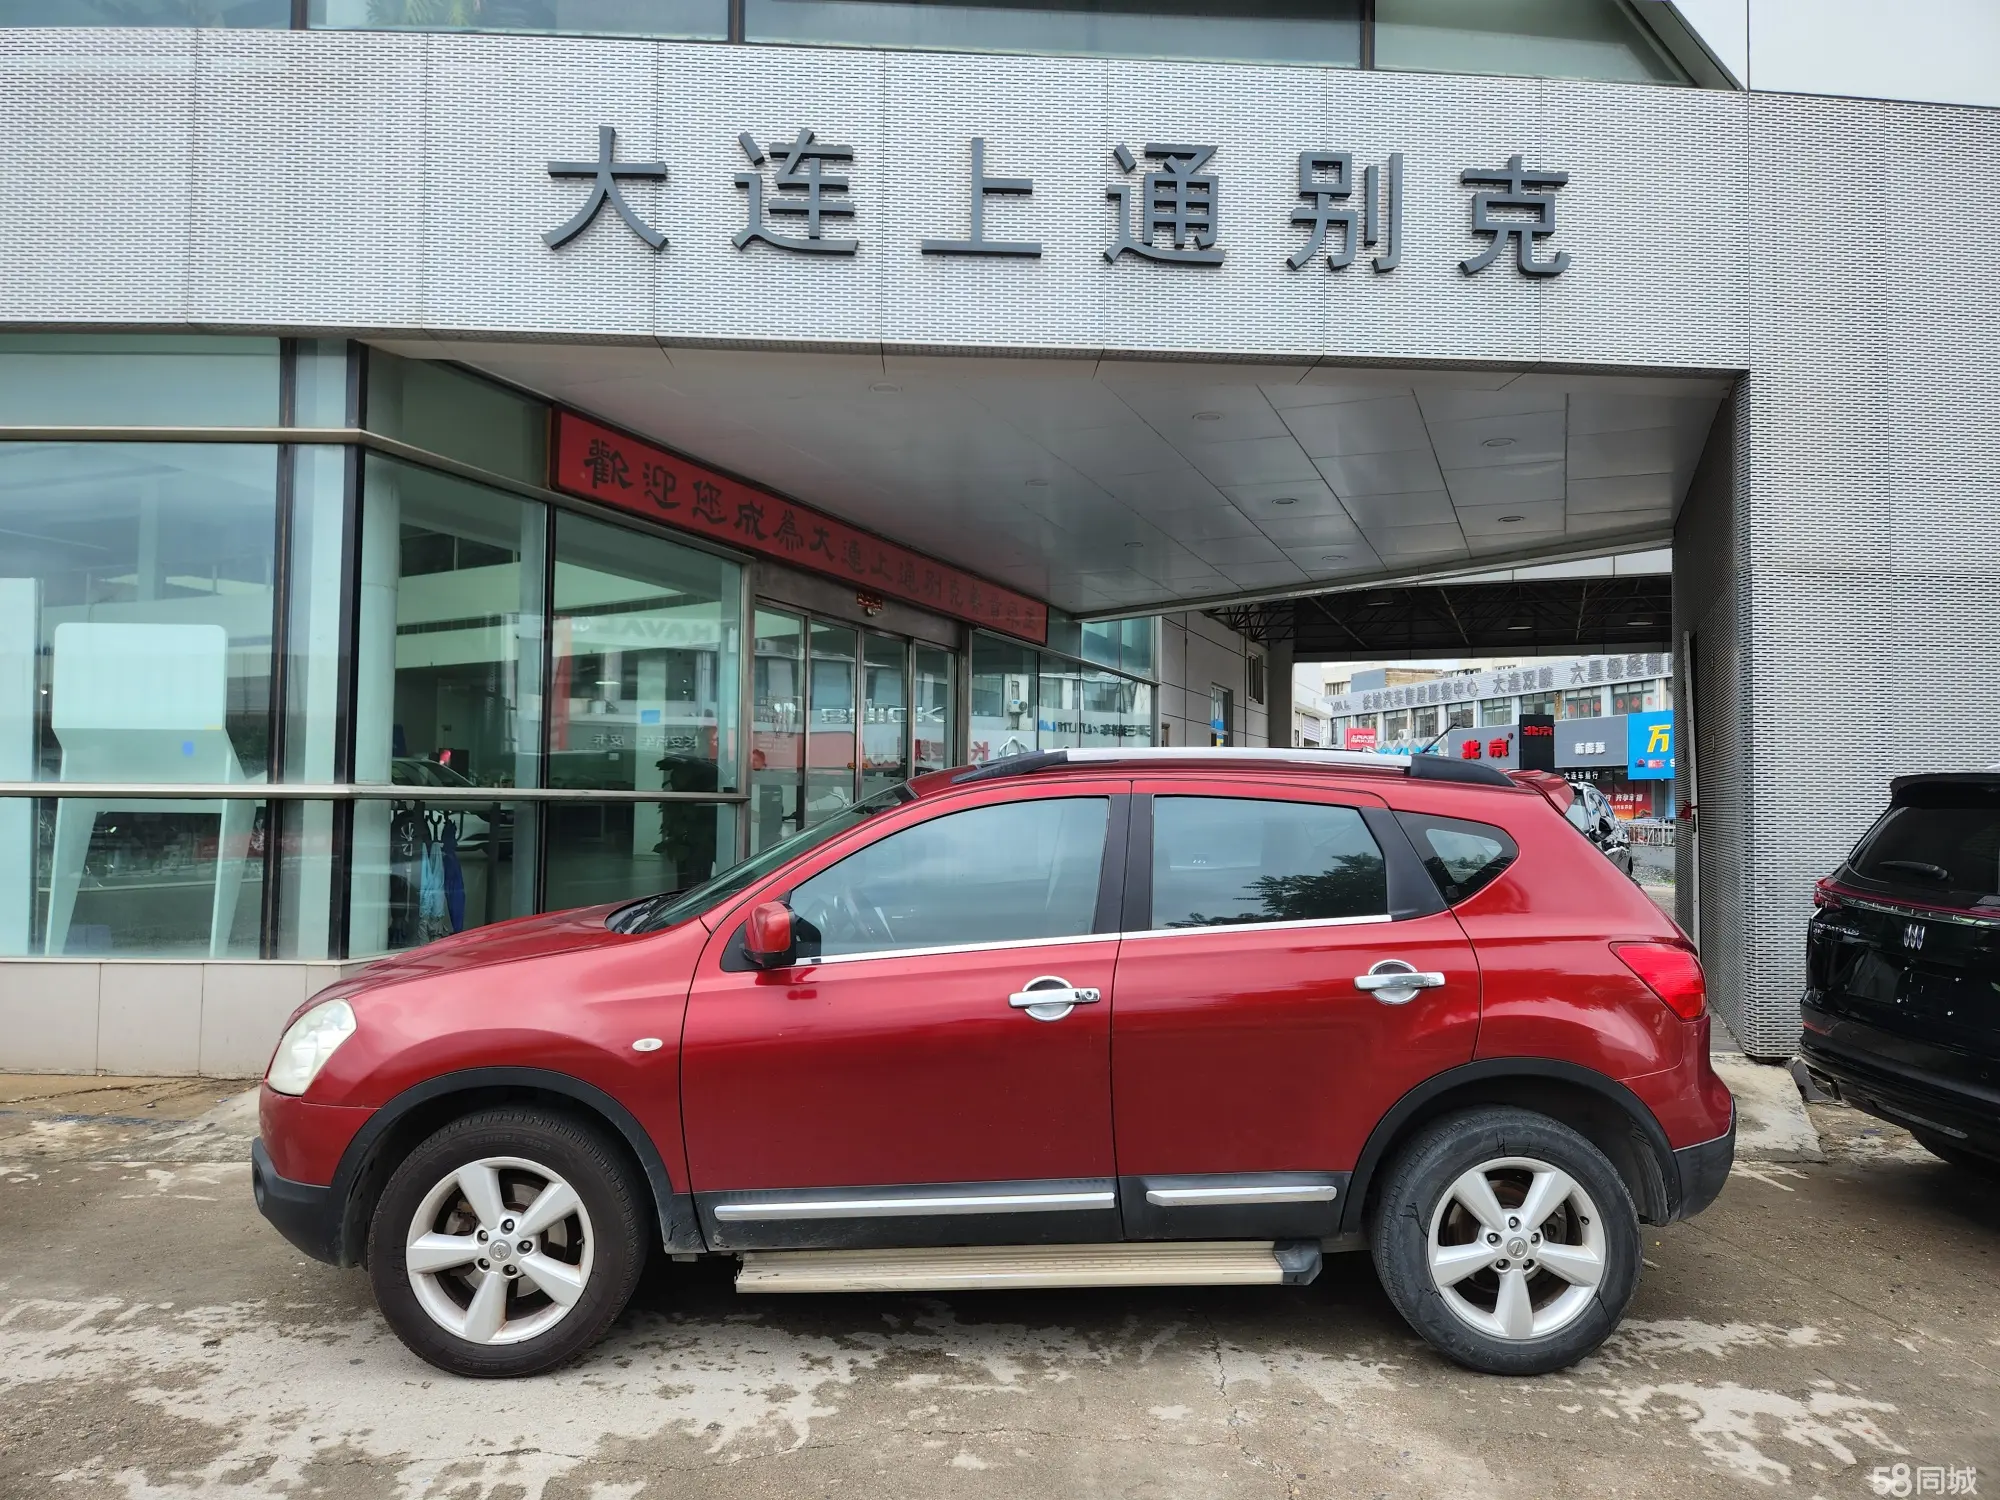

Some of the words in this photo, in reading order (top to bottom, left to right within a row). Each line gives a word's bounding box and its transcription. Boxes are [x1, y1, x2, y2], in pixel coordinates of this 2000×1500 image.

[542, 126, 1571, 278] 大连上通别克
[821, 706, 946, 724] BUICK
[1523, 726, 1552, 736] 北京
[1647, 724, 1671, 753] 万
[1462, 738, 1509, 759] 北京
[1575, 742, 1605, 755] 新能源
